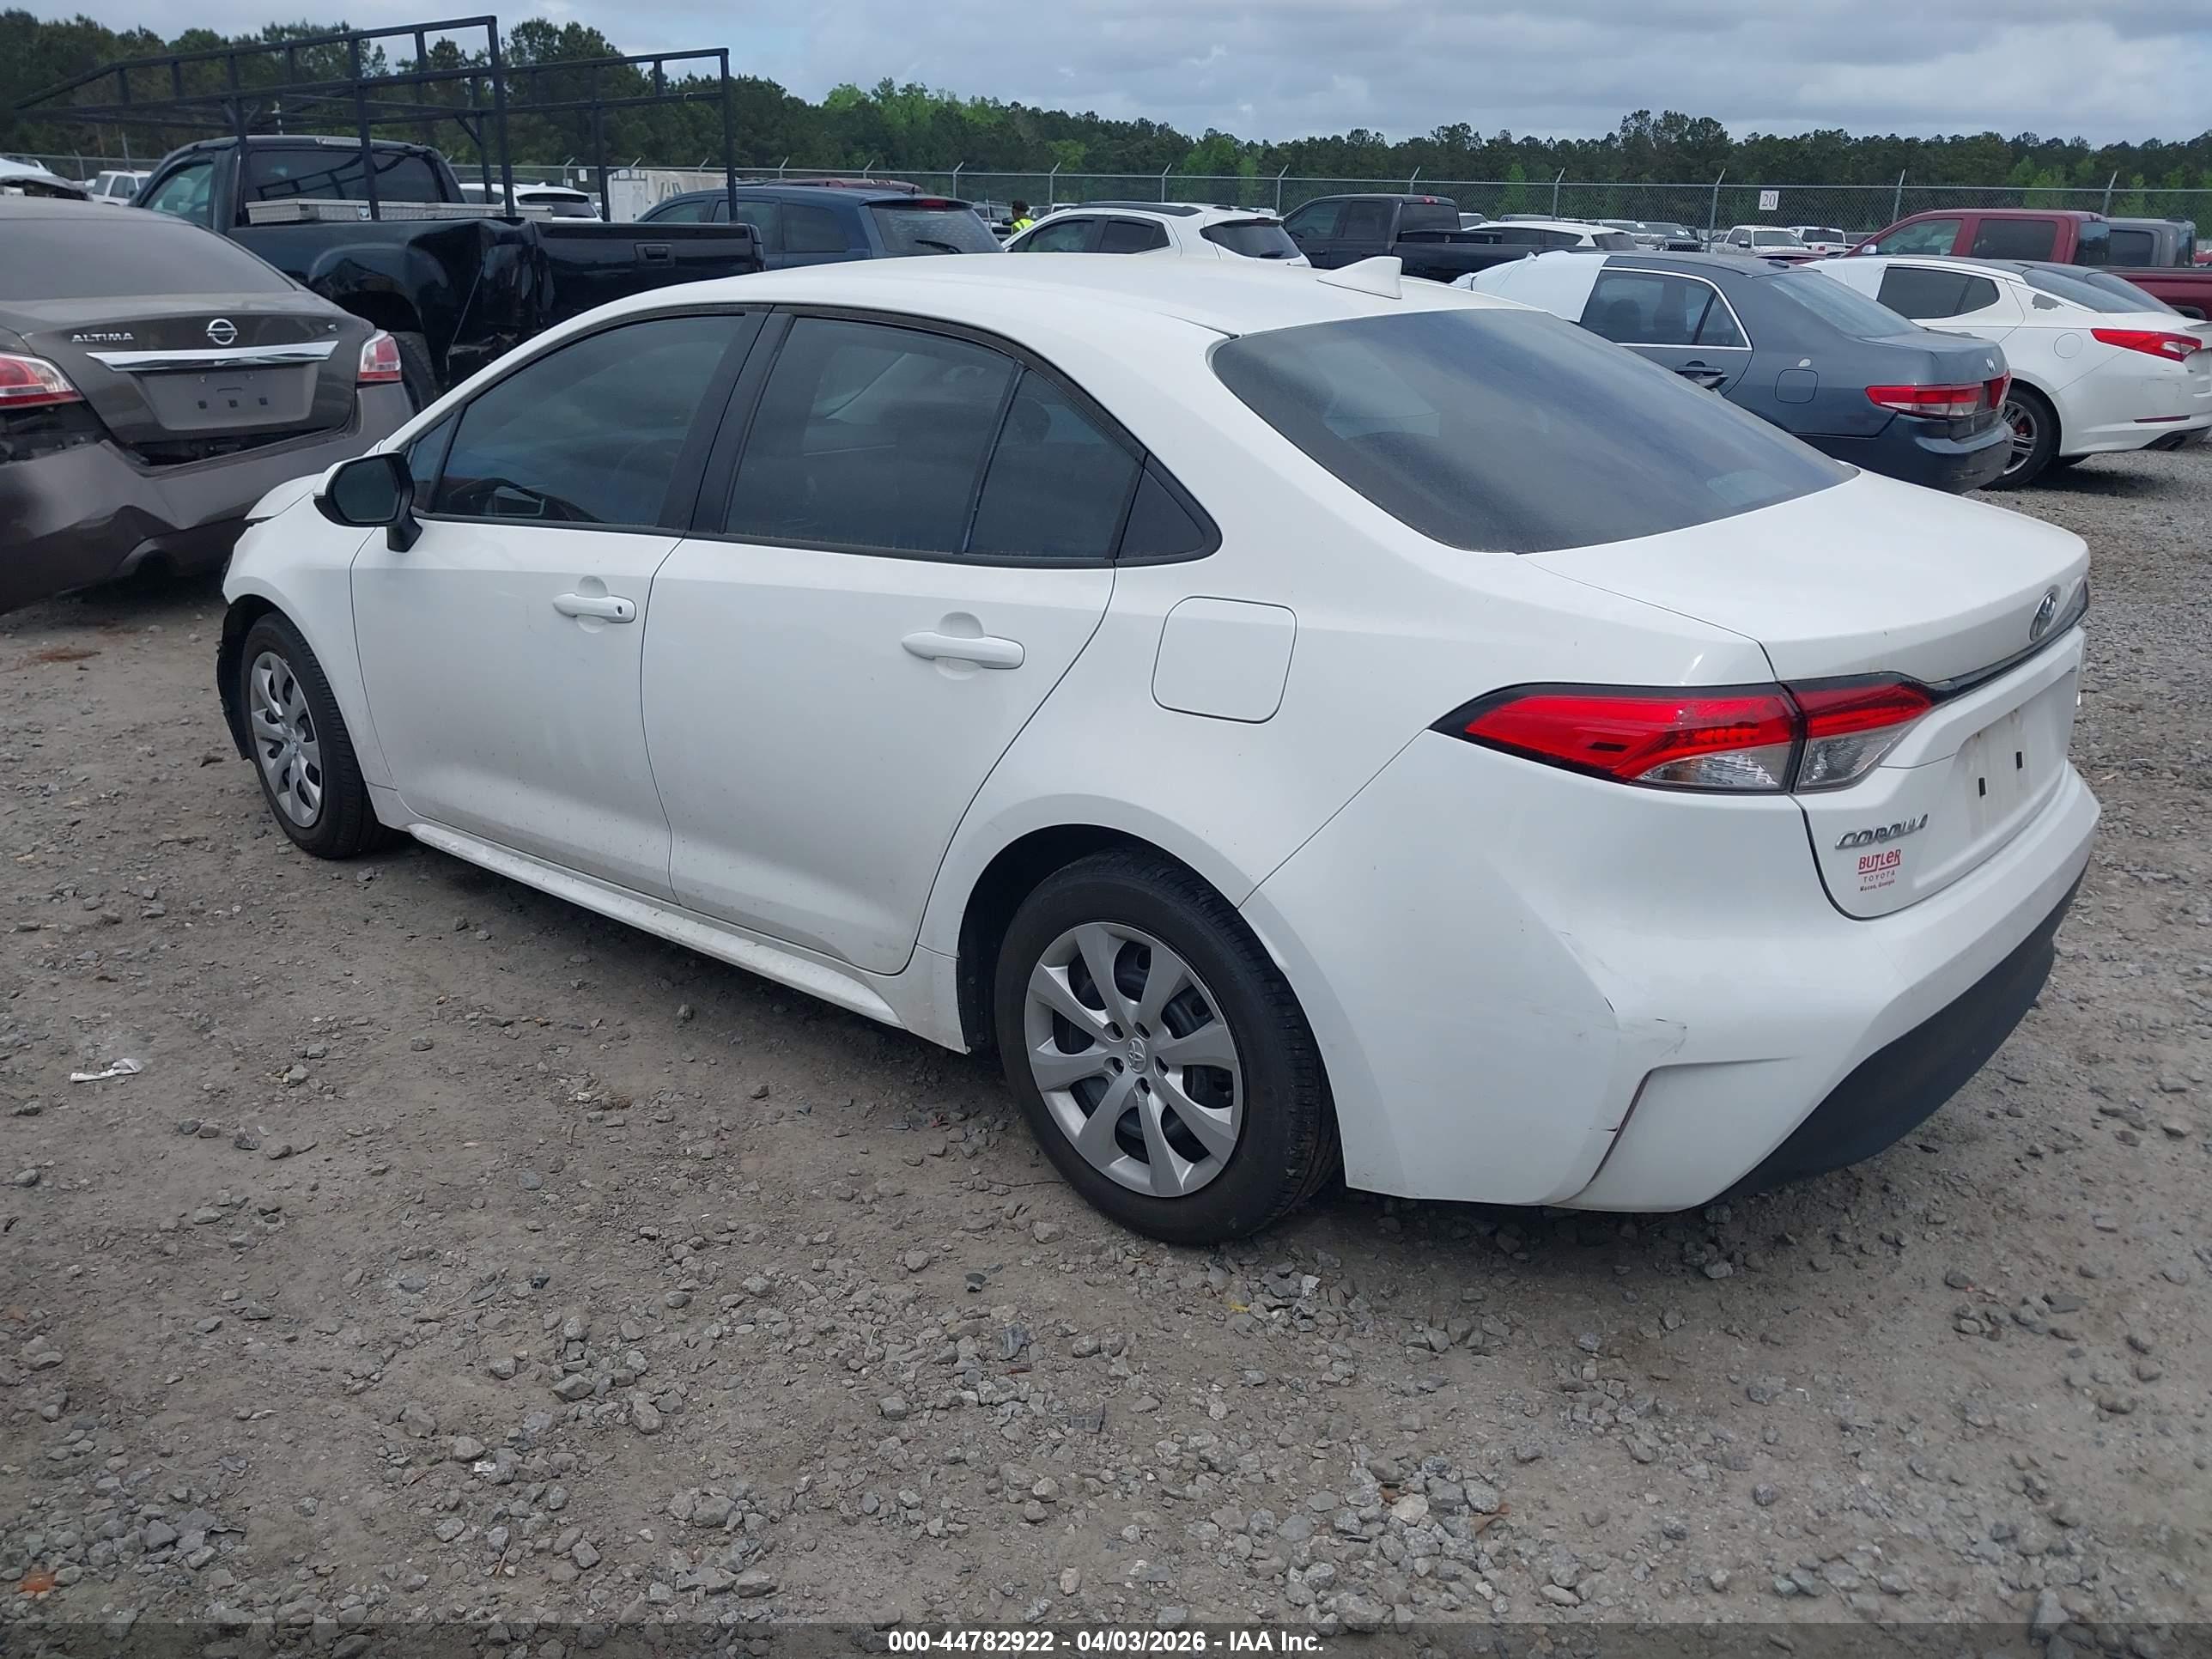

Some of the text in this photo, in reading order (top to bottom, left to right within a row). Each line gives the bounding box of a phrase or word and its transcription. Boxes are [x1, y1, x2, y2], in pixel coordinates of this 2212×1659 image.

[1761, 193, 1777, 208] 20
[71, 332, 135, 343] ALTIMA
[1834, 813, 1929, 850] COROLLA
[1863, 870, 1896, 884] TOYOTA
